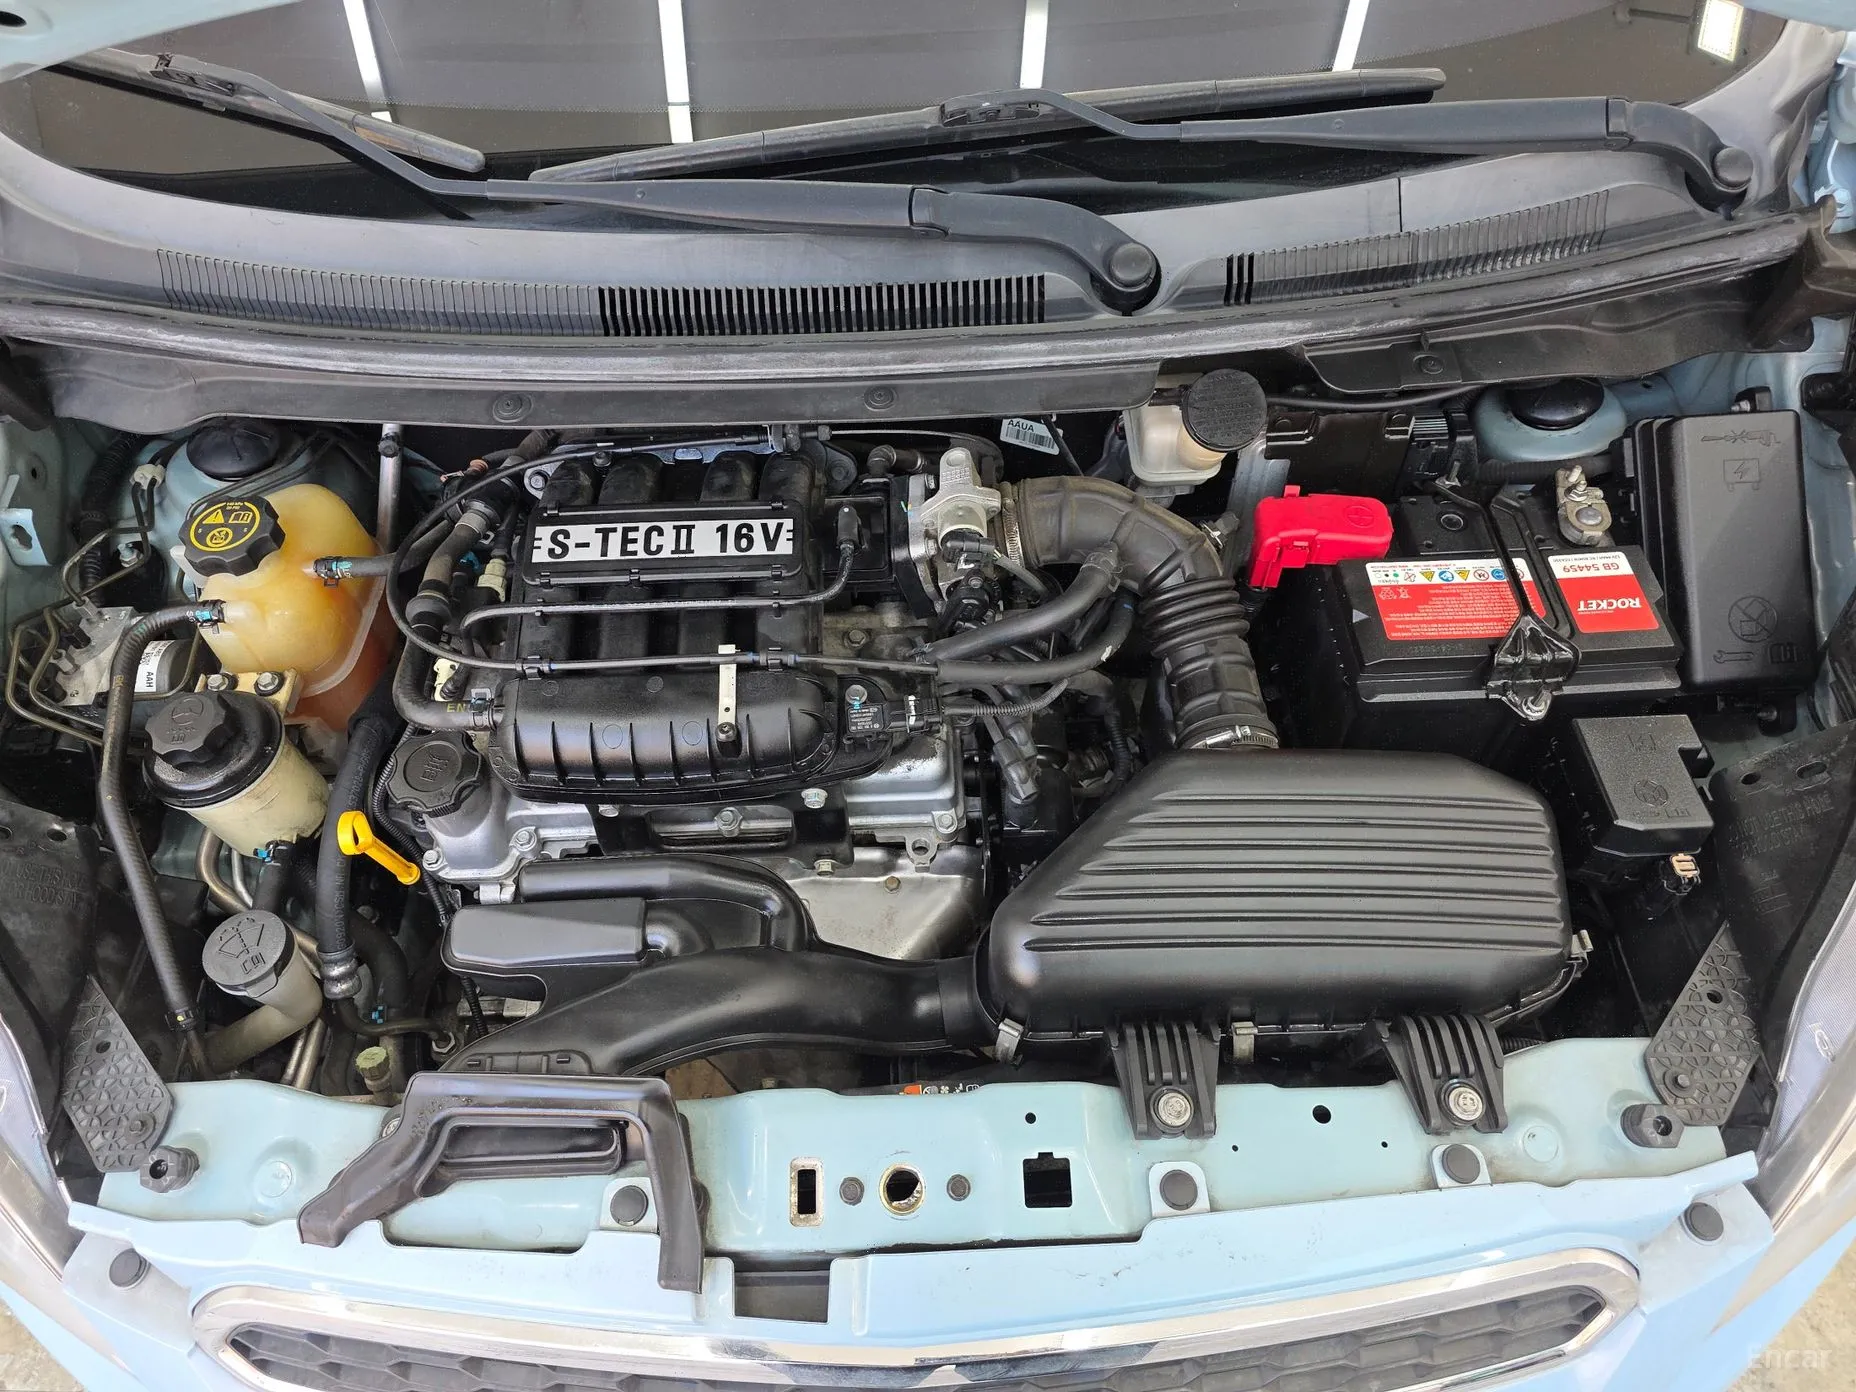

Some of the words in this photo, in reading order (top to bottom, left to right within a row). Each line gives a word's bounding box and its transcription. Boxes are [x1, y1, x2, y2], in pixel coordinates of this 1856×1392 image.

[1007, 419, 1035, 433] AAUA
[716, 521, 785, 554] 16V
[1563, 563, 1600, 572] 54459
[1602, 562, 1619, 570] GB
[1577, 597, 1642, 611] ROCKET
[145, 671, 154, 688] AAH
